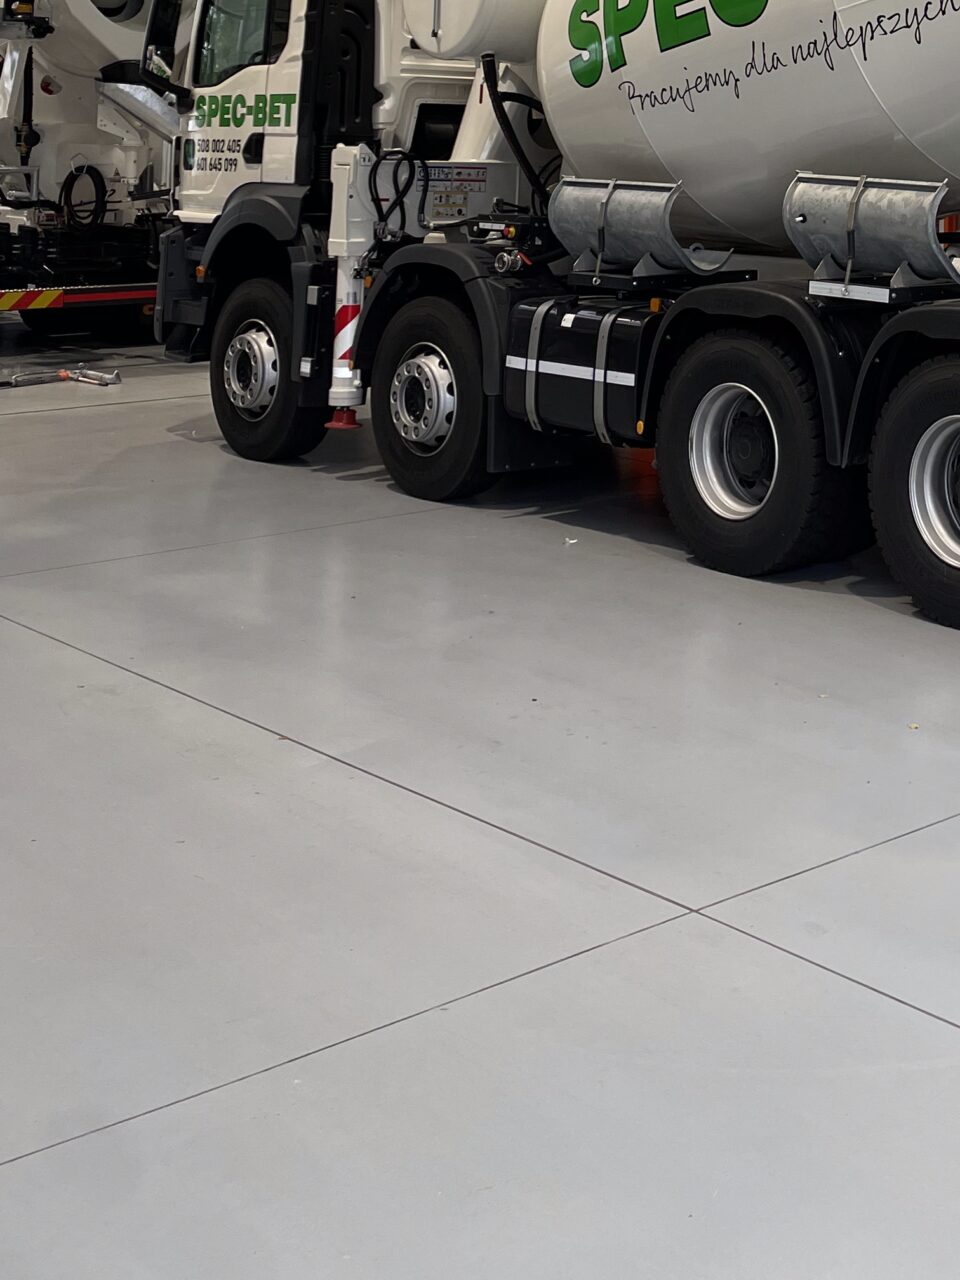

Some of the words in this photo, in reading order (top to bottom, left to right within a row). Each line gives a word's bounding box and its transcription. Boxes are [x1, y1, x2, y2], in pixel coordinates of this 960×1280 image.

[618, 67, 741, 115] Pracujemy
[744, 40, 788, 78] dla
[195, 93, 297, 128] SPEC-BET
[211, 138, 225, 153] 002
[227, 139, 241, 153] 405
[209, 157, 222, 171] 645
[224, 157, 238, 172] 099
